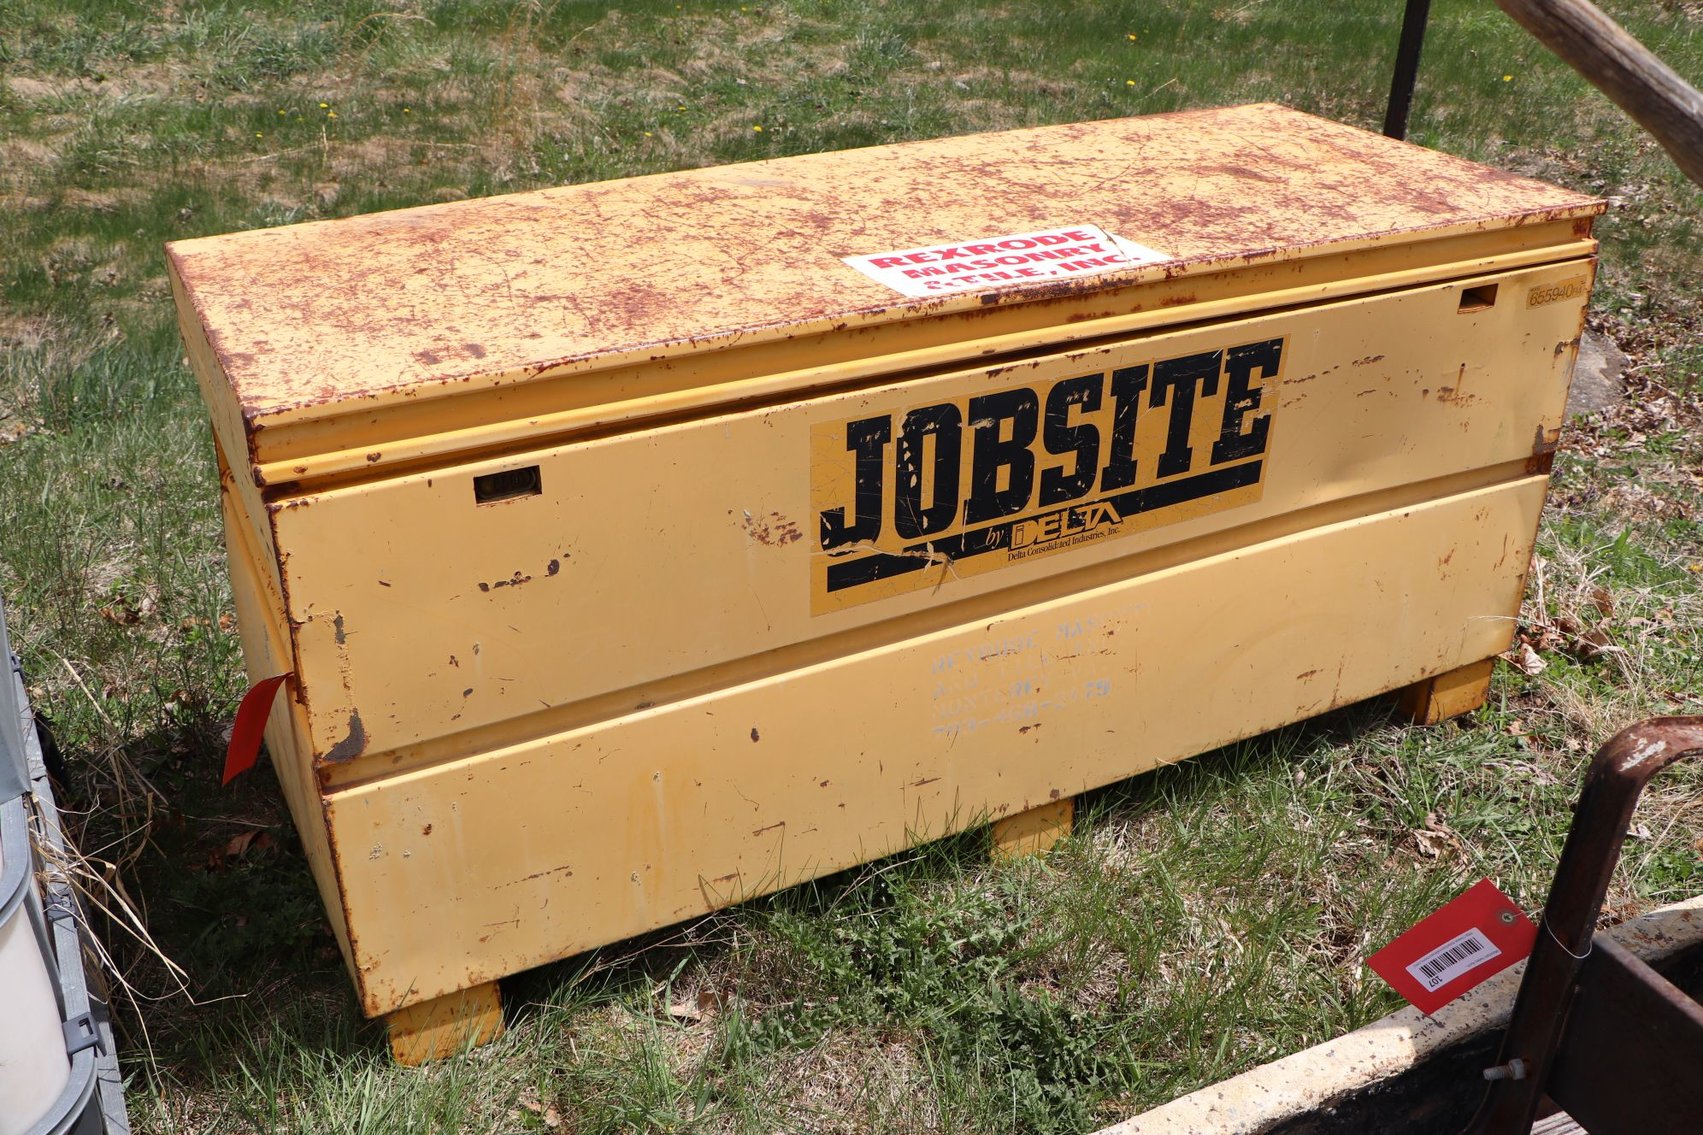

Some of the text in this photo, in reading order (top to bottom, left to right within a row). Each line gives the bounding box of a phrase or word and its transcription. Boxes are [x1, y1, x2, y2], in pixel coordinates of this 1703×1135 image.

[867, 230, 1096, 269] REXRODE
[901, 243, 1106, 279] MASONRY
[1057, 254, 1141, 272] INC.
[819, 337, 1284, 557] JOBSITE
[985, 501, 1121, 551] by DELTA
[1007, 548, 1027, 562] Delta
[1071, 531, 1107, 545] Industries,
[1107, 527, 1121, 536] Inc.
[1428, 975, 1443, 988] 107
